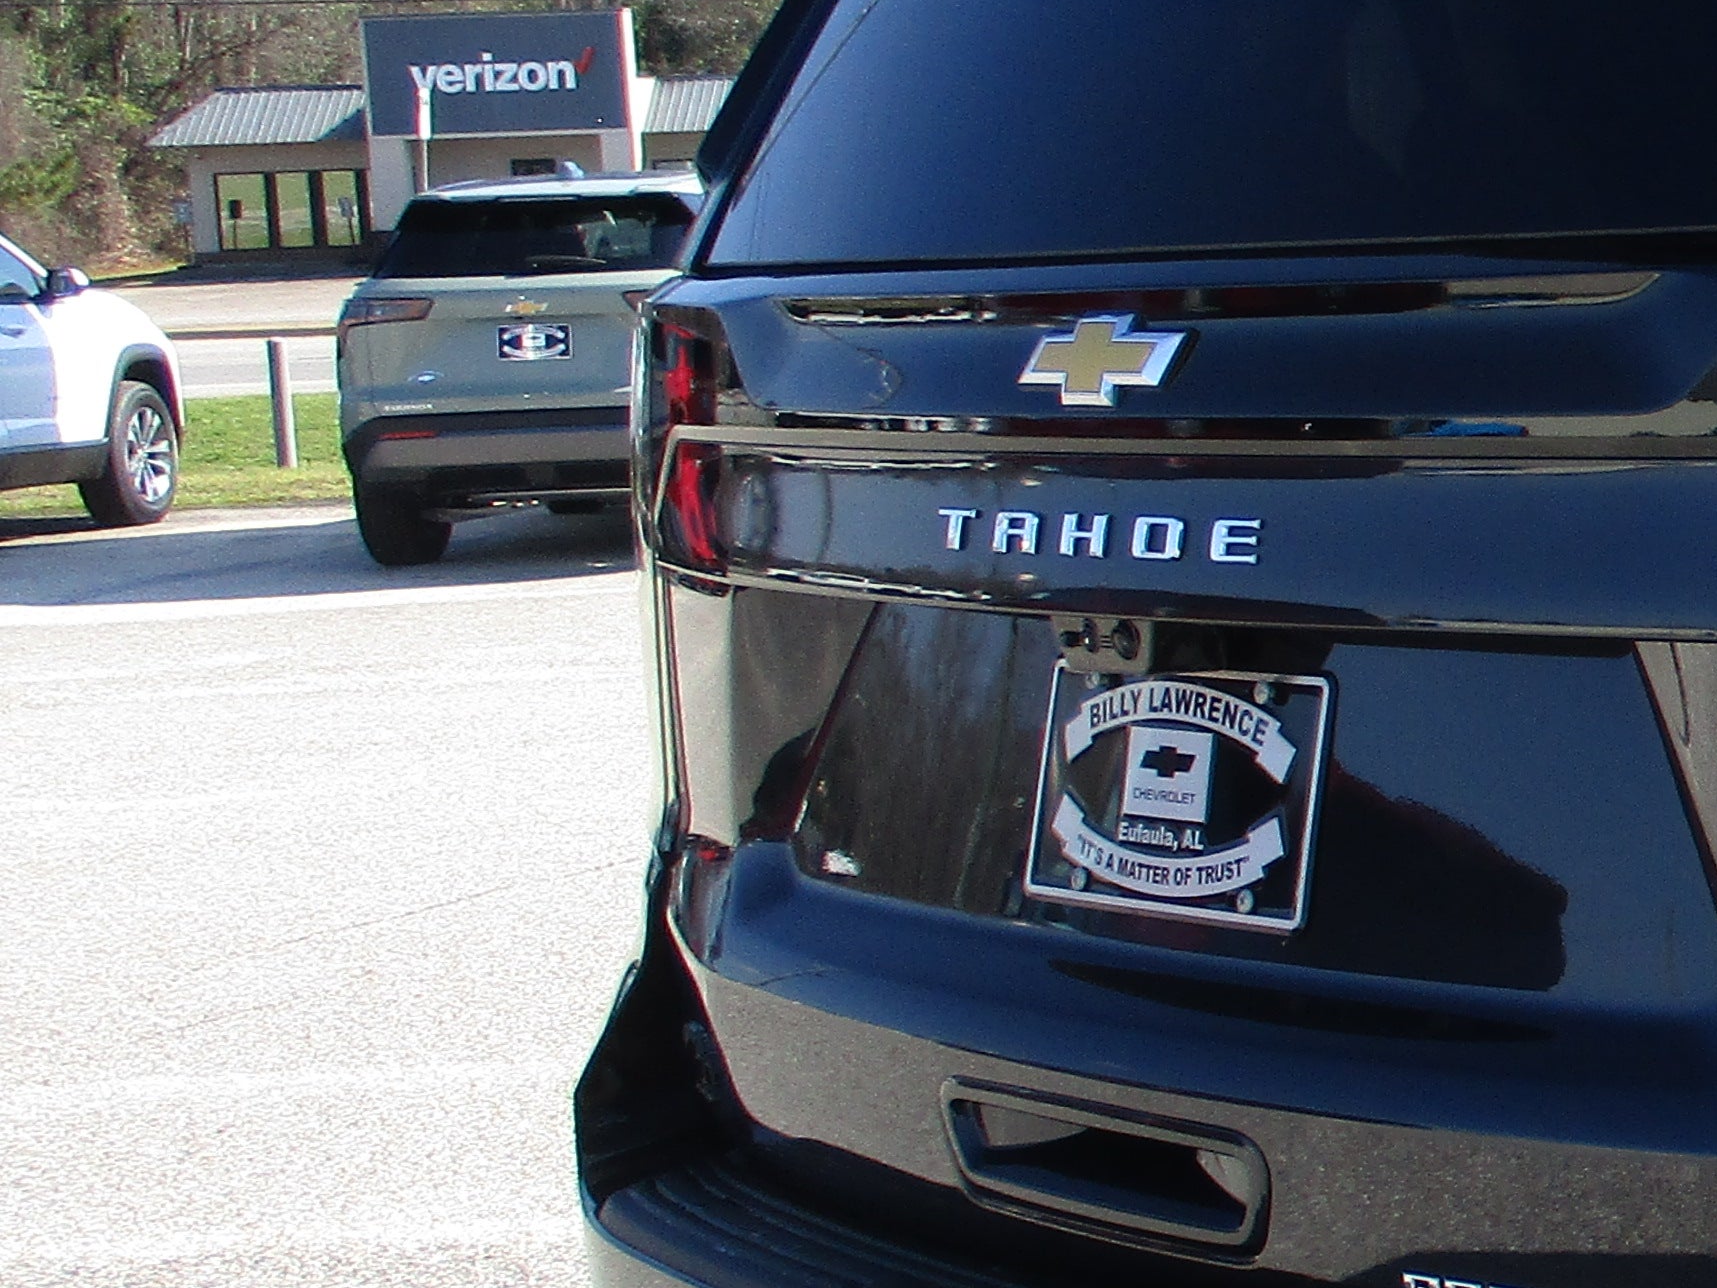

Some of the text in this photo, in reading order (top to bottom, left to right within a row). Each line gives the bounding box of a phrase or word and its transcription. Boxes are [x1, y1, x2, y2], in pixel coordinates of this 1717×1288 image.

[408, 52, 577, 94] verizon
[938, 508, 1262, 565] TAHOE
[1089, 687, 1272, 746] BILLY LAWRENCE
[1132, 786, 1196, 805] CHEVROLET
[1118, 821, 1205, 852] Eufaula, AL
[1104, 851, 1117, 871] A
[1116, 857, 1171, 887] MATTER
[1173, 867, 1193, 887] OF
